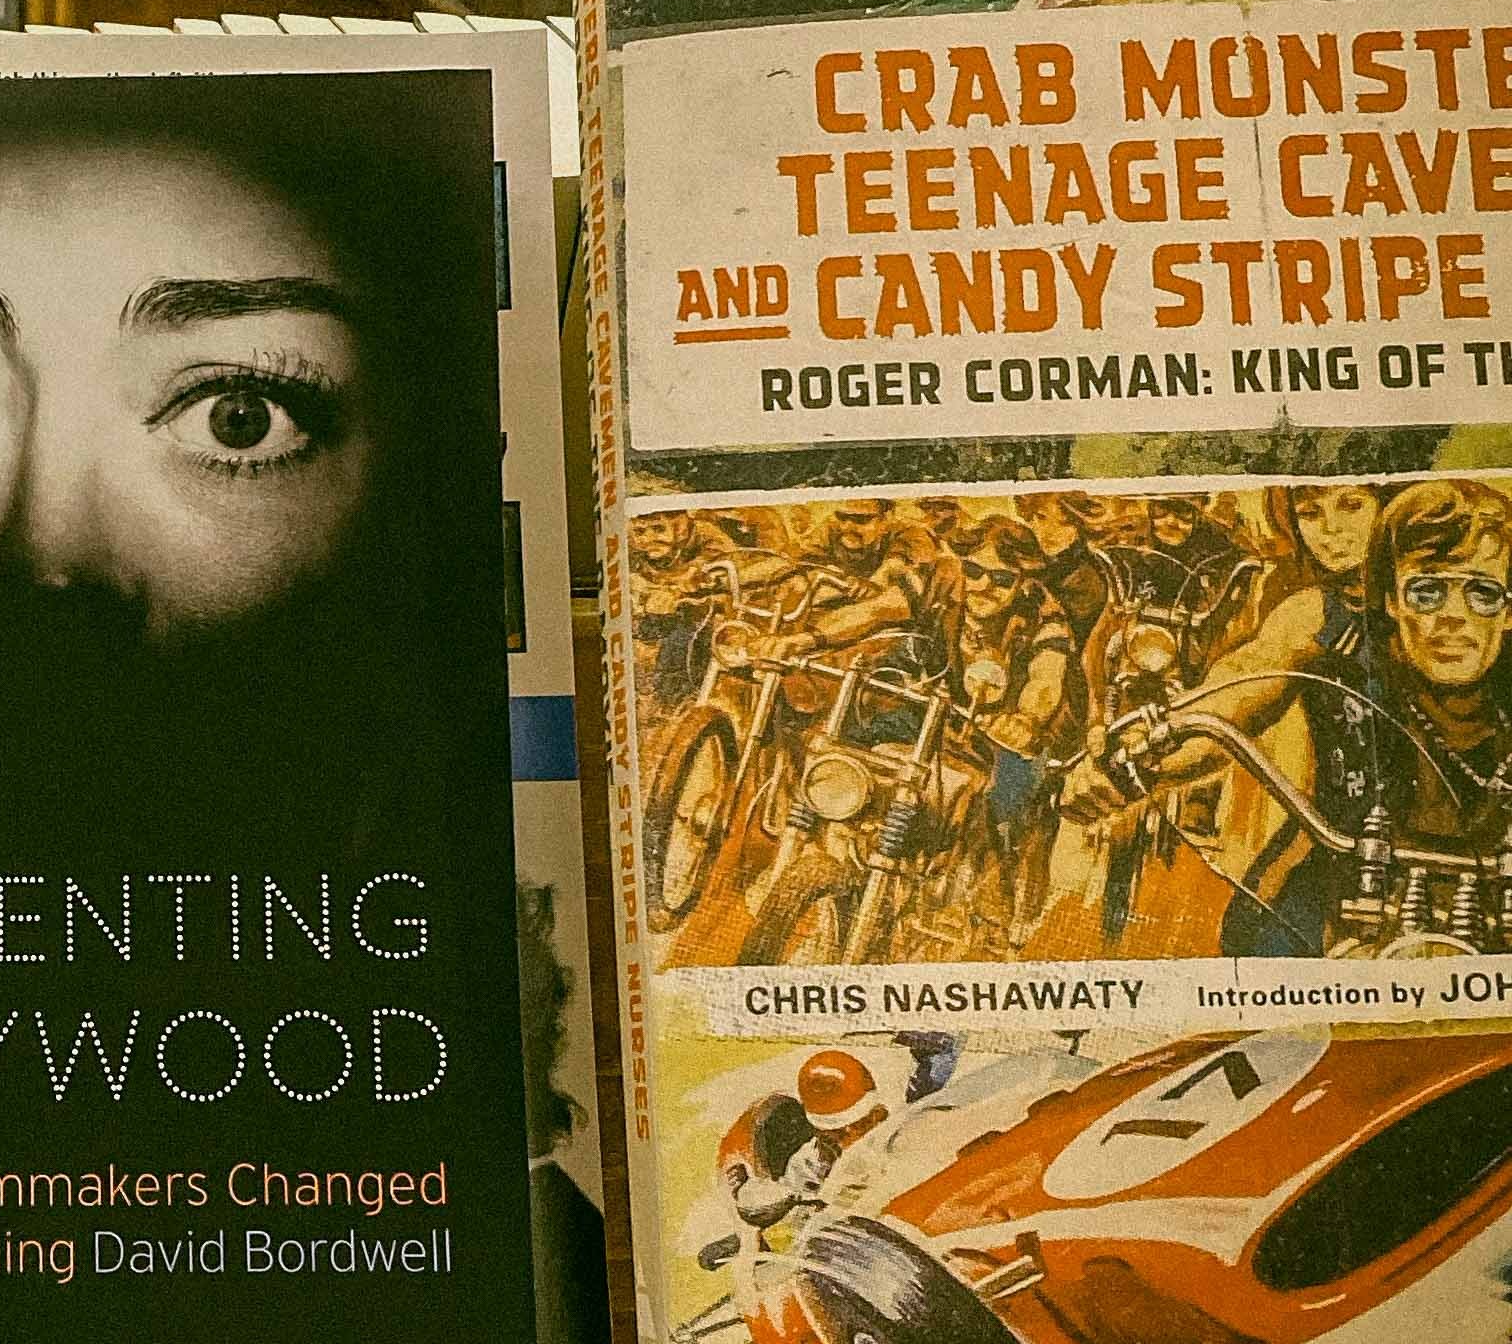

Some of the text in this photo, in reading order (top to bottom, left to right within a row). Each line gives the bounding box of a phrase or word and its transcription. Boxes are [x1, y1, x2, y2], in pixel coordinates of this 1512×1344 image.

[814, 44, 1078, 136] CRAB
[586, 107, 609, 299] TEENAGE
[777, 126, 1512, 239] TEENAGE CAVE
[677, 233, 1493, 341] AND CANDY STRIPE
[761, 360, 941, 413] ROGER
[965, 351, 1214, 406] CORMAN:
[1232, 344, 1359, 394] KING
[1378, 341, 1445, 390] OF
[605, 535, 624, 621] AND
[609, 632, 631, 770] CANDY
[617, 783, 640, 945] STRIPE
[744, 984, 867, 1017] CHRIS
[882, 979, 1145, 1016] NASHAWATY
[1197, 980, 1381, 1009] Introduction
[1391, 981, 1425, 1009] by
[627, 960, 651, 1141] NURSES
[227, 1160, 449, 1217] Changed
[93, 1229, 226, 1275] David
[244, 1226, 453, 1275] Bordwell
